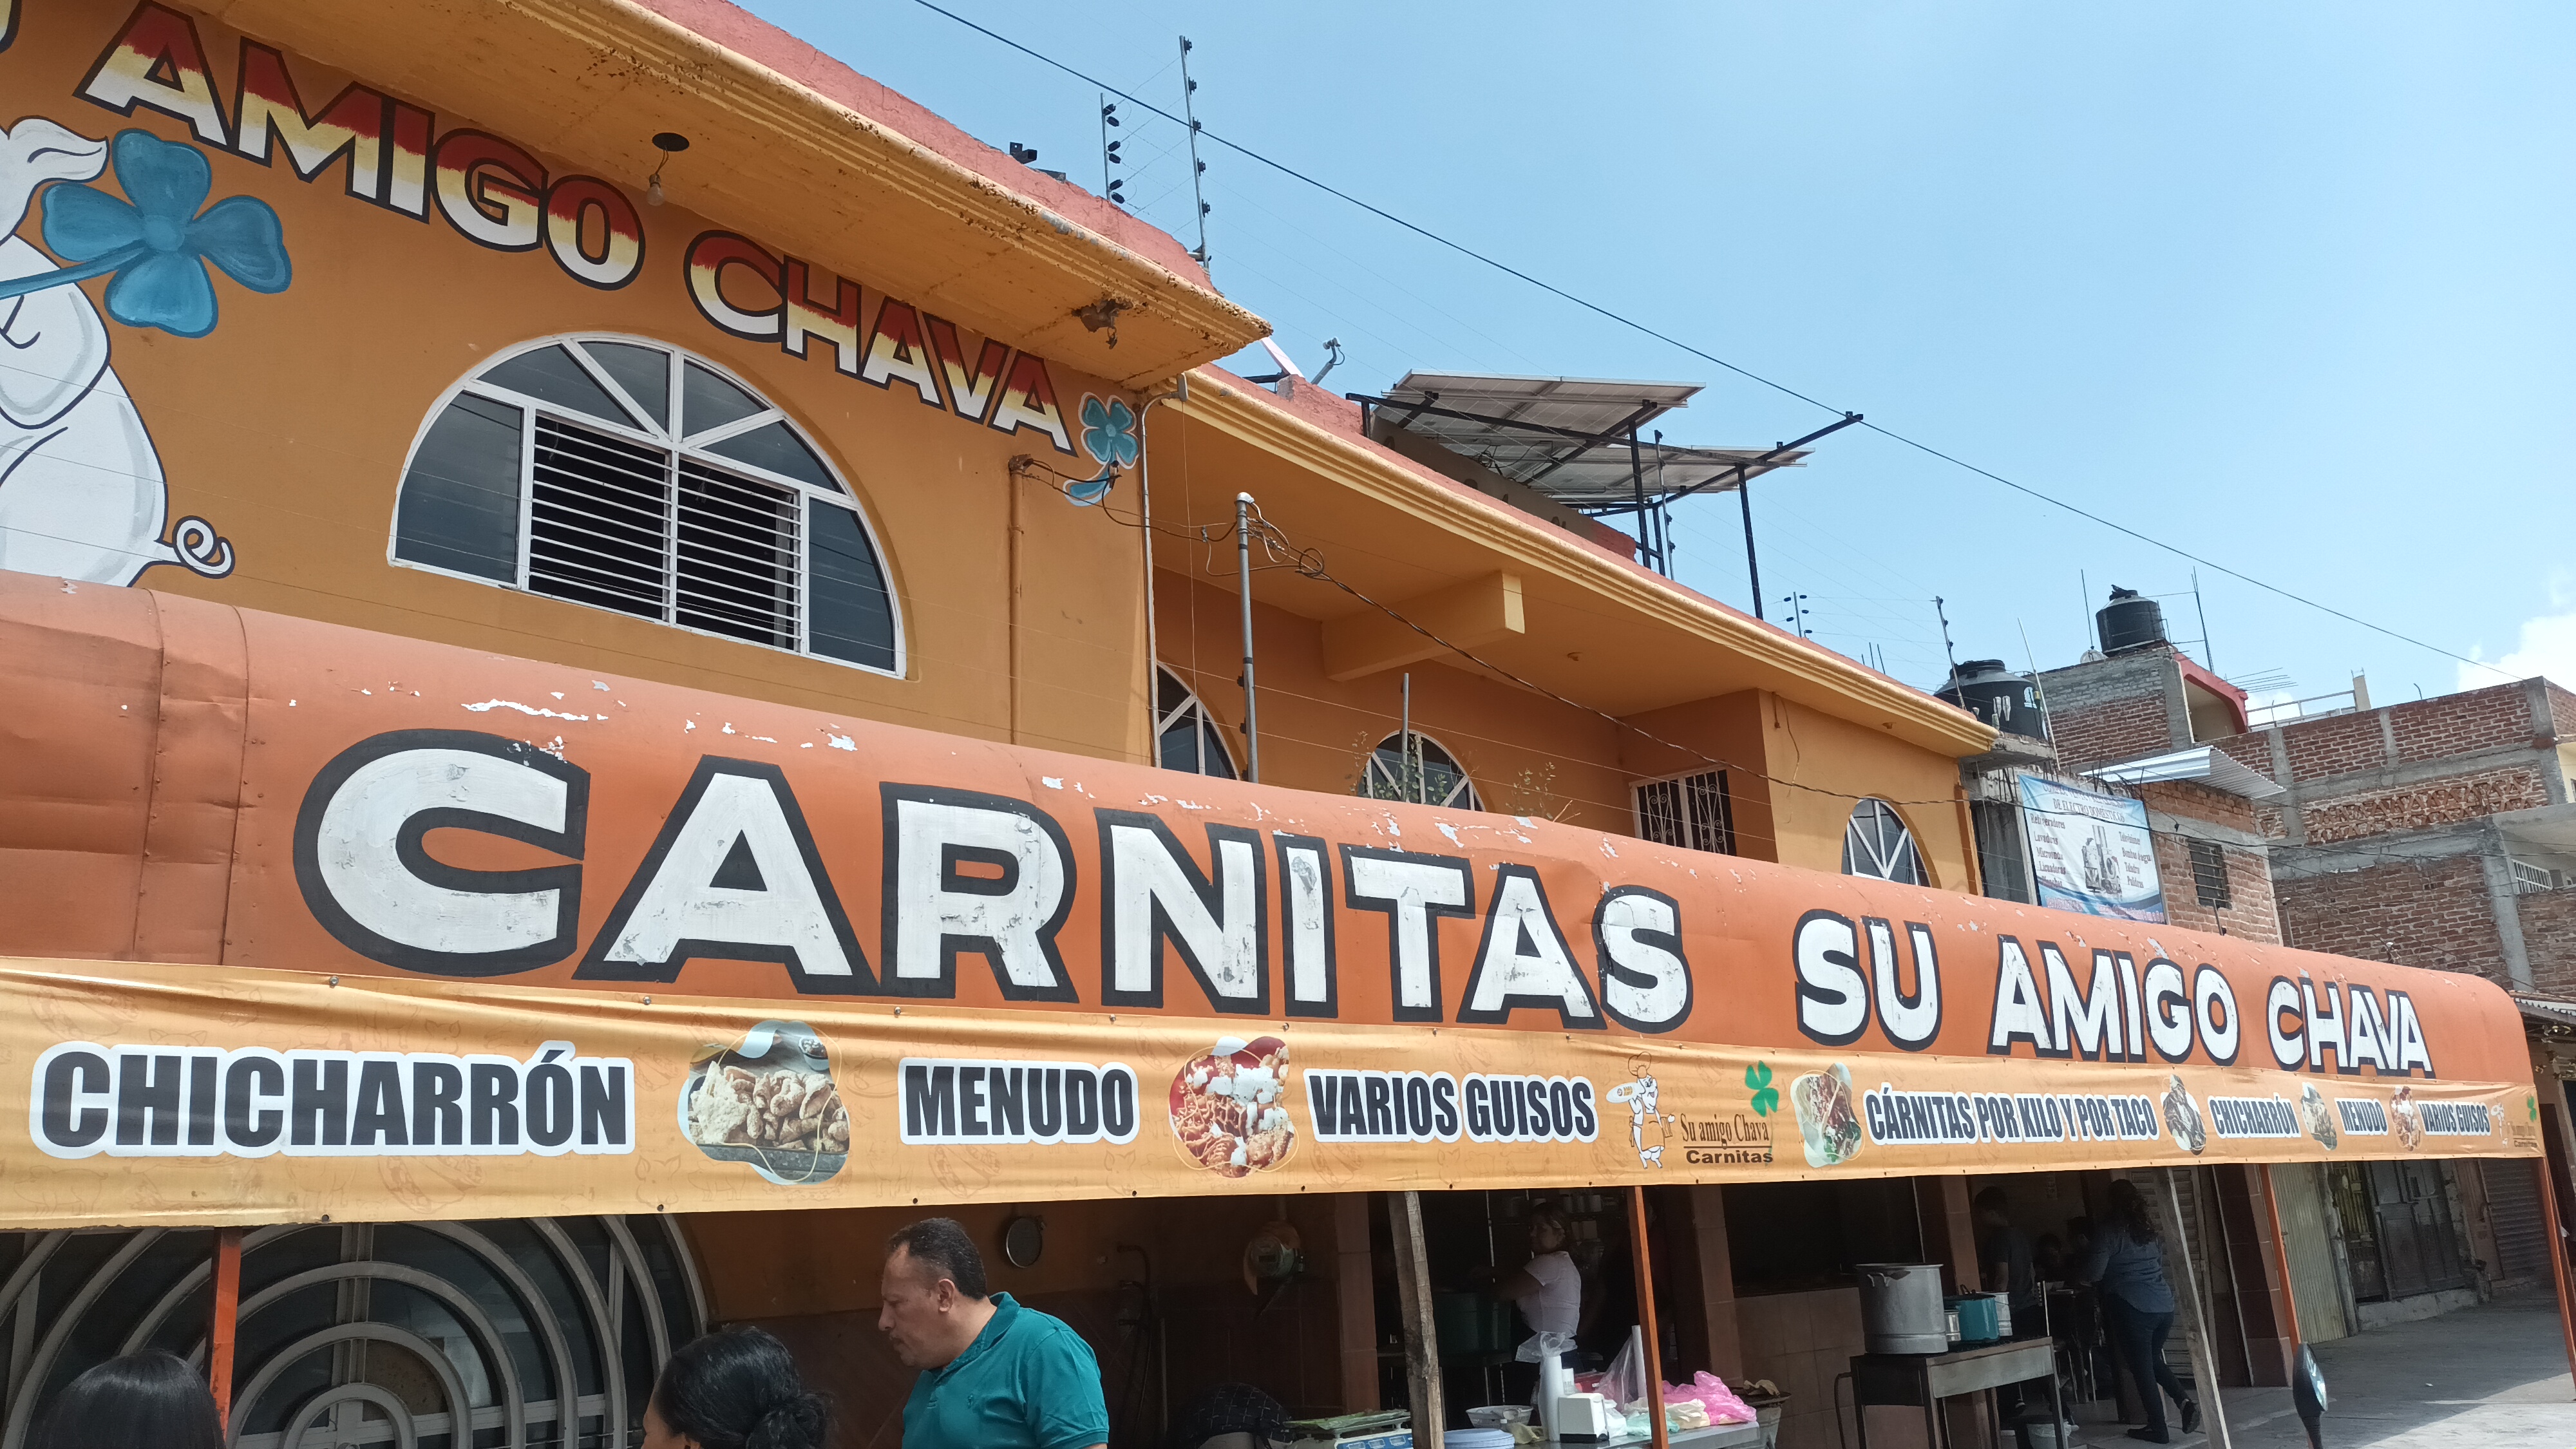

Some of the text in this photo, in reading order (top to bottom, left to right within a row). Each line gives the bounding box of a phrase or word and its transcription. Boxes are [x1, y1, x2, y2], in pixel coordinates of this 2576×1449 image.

[73, 0, 1077, 457] AMIGO CHAVA
[293, 728, 2436, 1079] CARNITAS SU AMIGO CHAVA
[42, 1050, 1596, 1148] CHICHARRÓN MENUDO VARIOS GUISOS
[1680, 1113, 1770, 1149] Su amigo Chava
[1866, 1087, 1976, 1140] CÁRNITAS
[1974, 1095, 2020, 1139] POR
[2016, 1097, 2062, 1138] KILO
[2059, 1098, 2076, 1137] Y
[2075, 1098, 2115, 1137] POR
[2110, 1099, 2157, 1137] TACO
[2209, 1095, 2298, 1135] CHICHARRÓN
[2336, 1099, 2387, 1135] MENUDO
[2418, 1103, 2457, 1133] VARIOS
[2456, 1104, 2490, 1133] GUISOS
[1687, 1150, 1774, 1164] Carnitas
